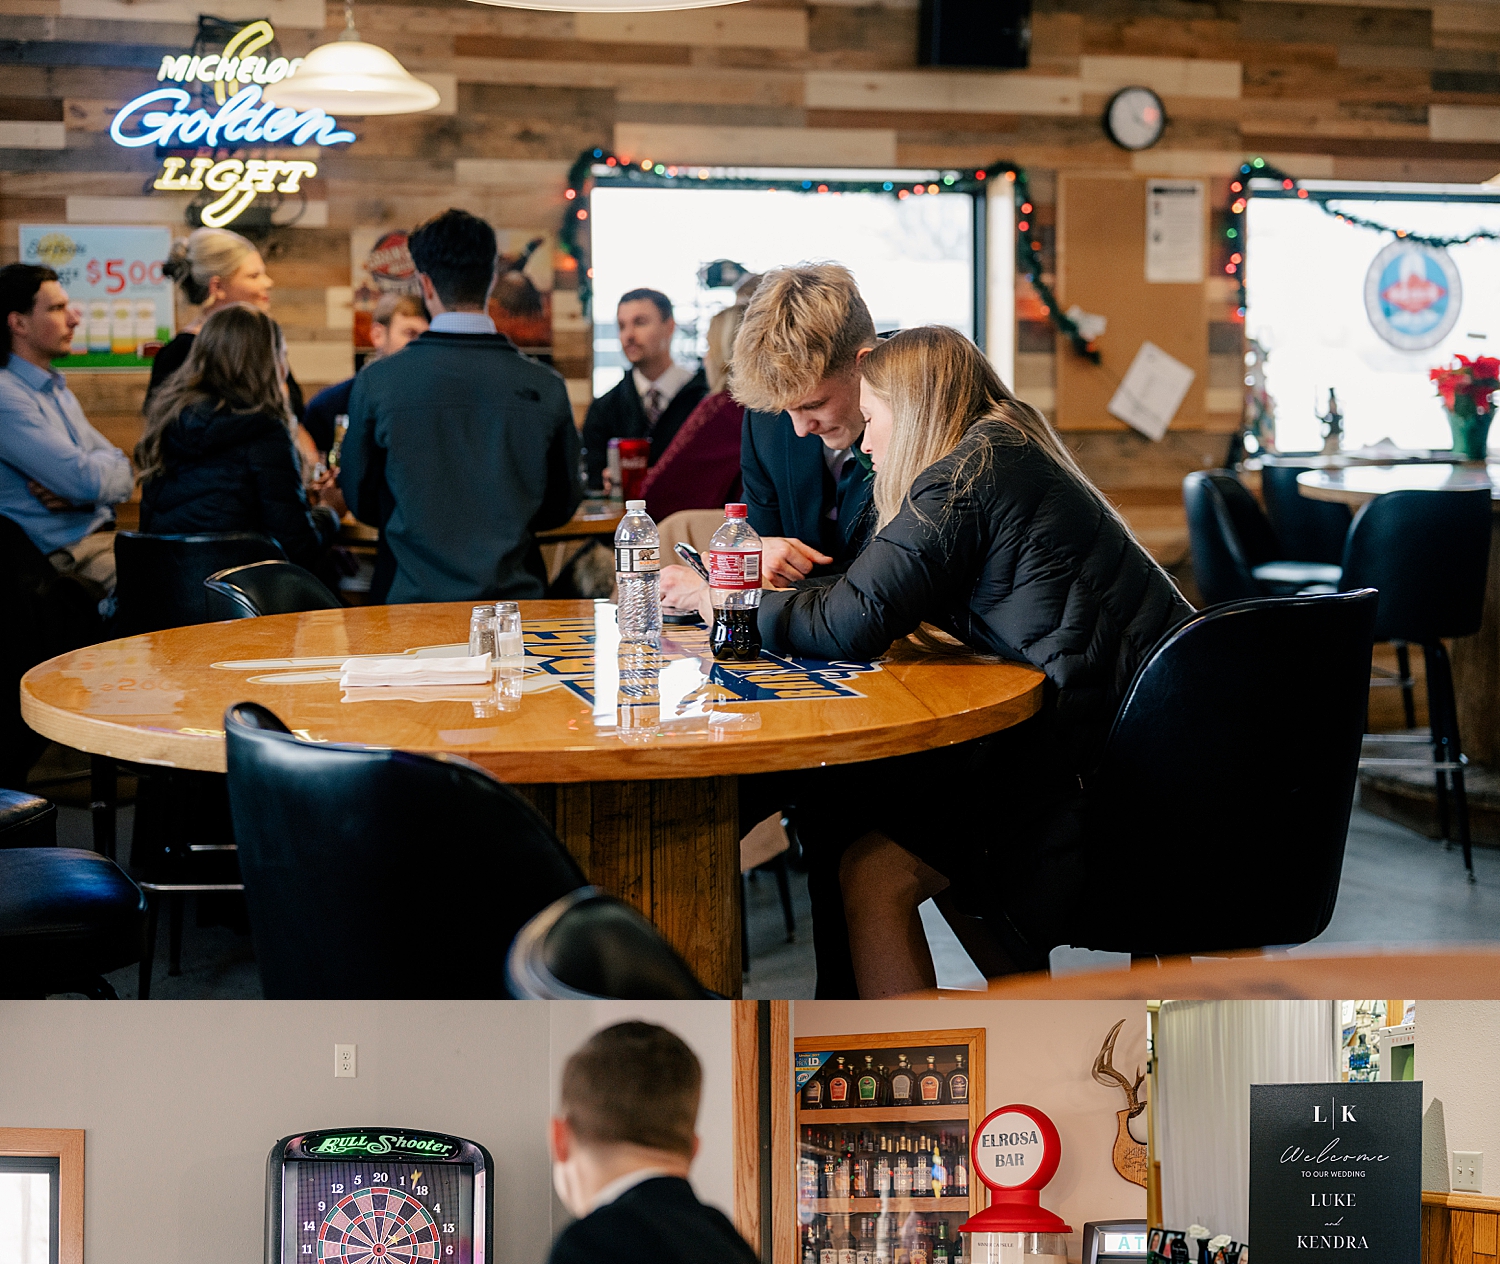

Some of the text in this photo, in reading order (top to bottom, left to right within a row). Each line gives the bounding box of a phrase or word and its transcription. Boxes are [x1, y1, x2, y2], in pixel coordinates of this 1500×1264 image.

[110, 85, 356, 147] Golden
[153, 157, 317, 192] LIGHT
[1313, 1105, 1357, 1123] L K
[982, 1131, 1038, 1147] ELROSA
[367, 1135, 453, 1156] Shooter
[1280, 1137, 1390, 1164] Welcome
[995, 1153, 1024, 1167] BAR
[354, 1175, 362, 1185] 5
[373, 1172, 388, 1183] 20
[400, 1176, 405, 1186] 1
[331, 1184, 344, 1194] 12
[416, 1186, 428, 1196] 18
[1310, 1193, 1356, 1207] LUKE
[318, 1201, 326, 1211] 9
[433, 1203, 441, 1213] 4
[303, 1221, 315, 1231] 14
[1324, 1217, 1343, 1227] and
[443, 1223, 455, 1233] 13
[1297, 1235, 1369, 1249] KENDRA
[302, 1245, 312, 1254] 11
[446, 1246, 454, 1255] 6
